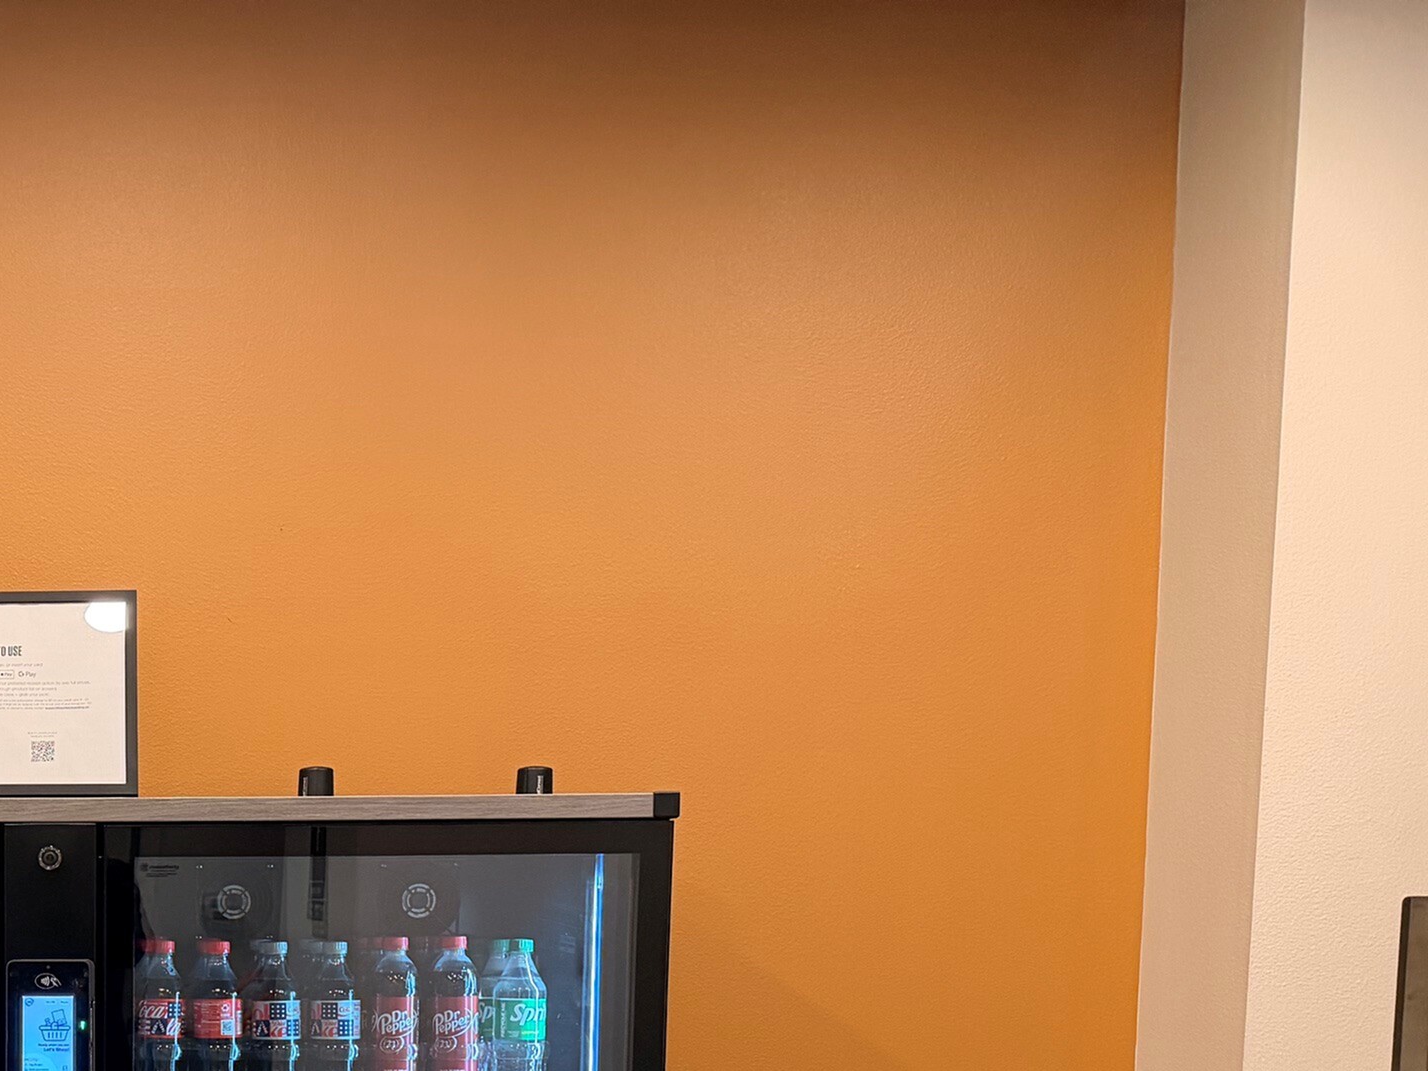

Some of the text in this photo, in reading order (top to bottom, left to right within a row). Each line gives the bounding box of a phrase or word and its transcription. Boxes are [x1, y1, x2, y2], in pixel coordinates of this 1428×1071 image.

[8, 645, 23, 657] USE
[444, 1009, 461, 1020] Dr
[433, 1013, 471, 1035] Pepper
